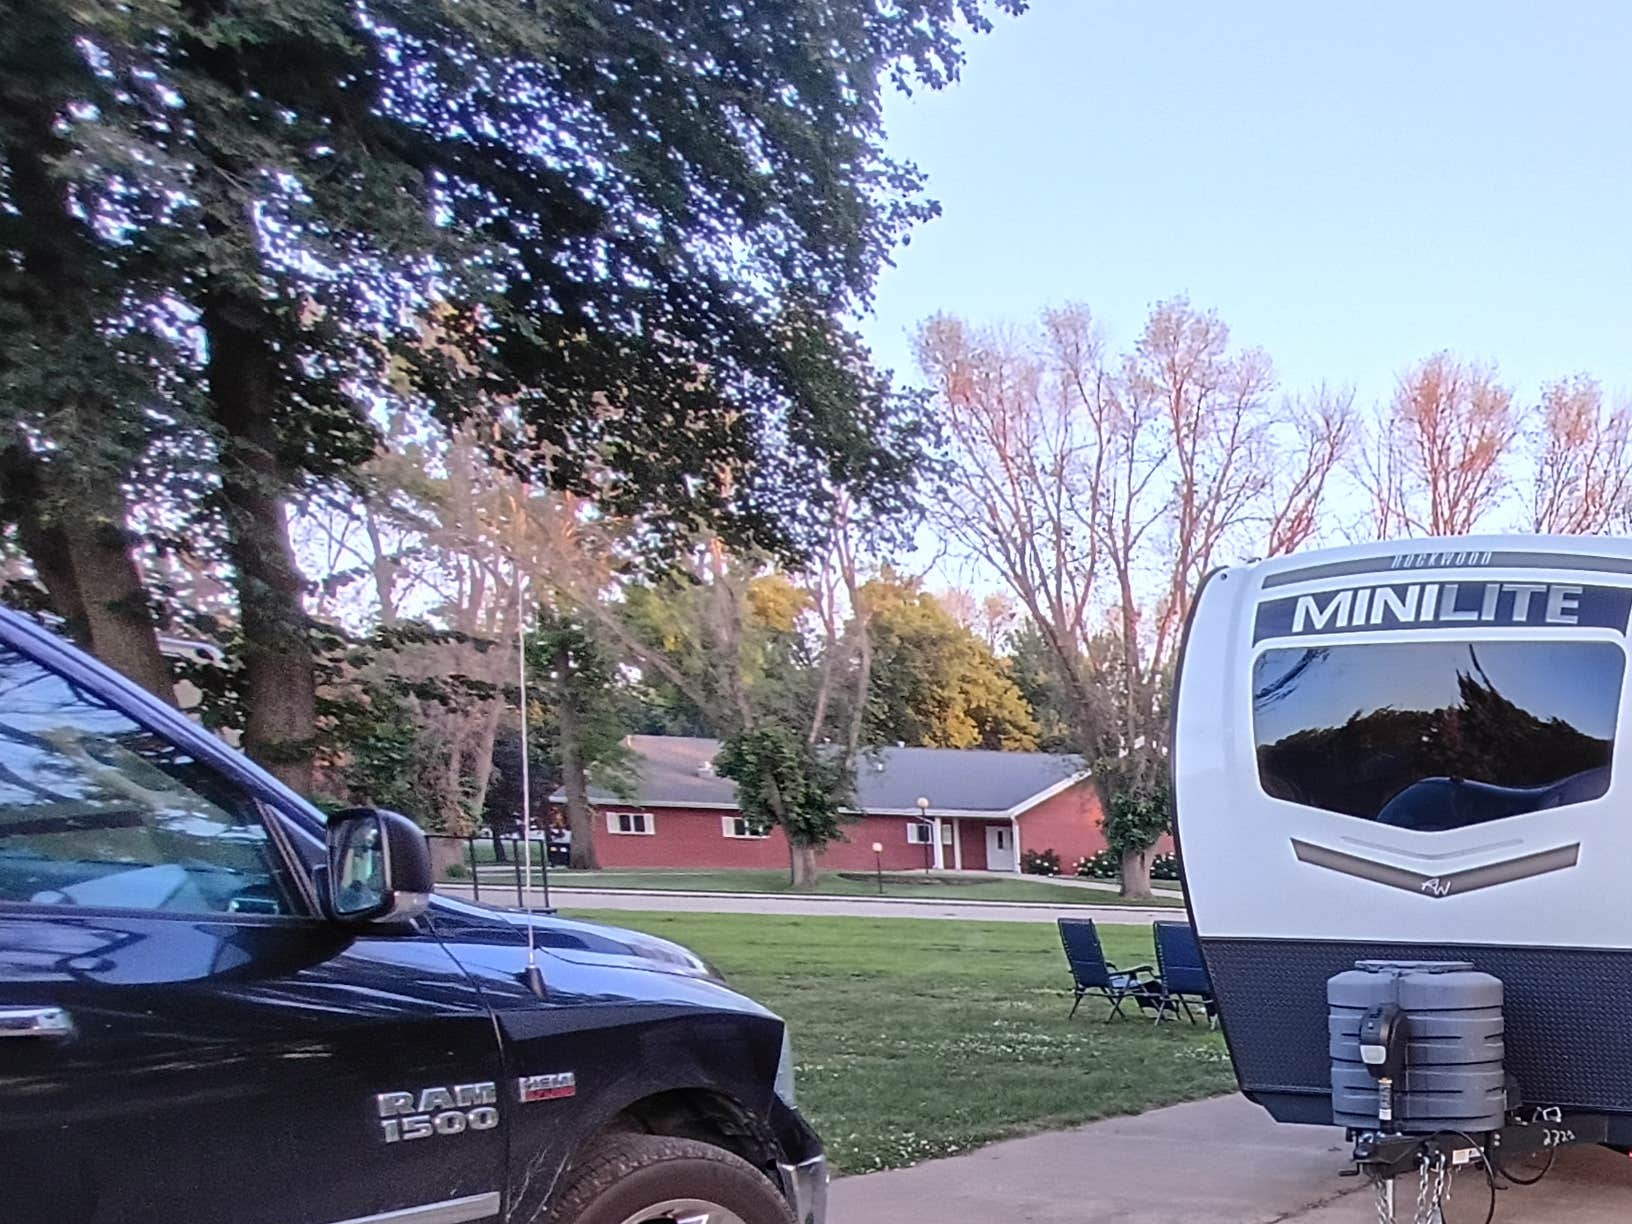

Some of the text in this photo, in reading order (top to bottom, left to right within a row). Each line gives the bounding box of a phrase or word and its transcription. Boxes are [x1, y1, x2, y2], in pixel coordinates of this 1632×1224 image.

[1390, 551, 1493, 569] ROCKWOOD
[1291, 583, 1584, 633] MINILITE
[377, 1081, 497, 1118] RAM
[380, 1106, 500, 1144] 1500
